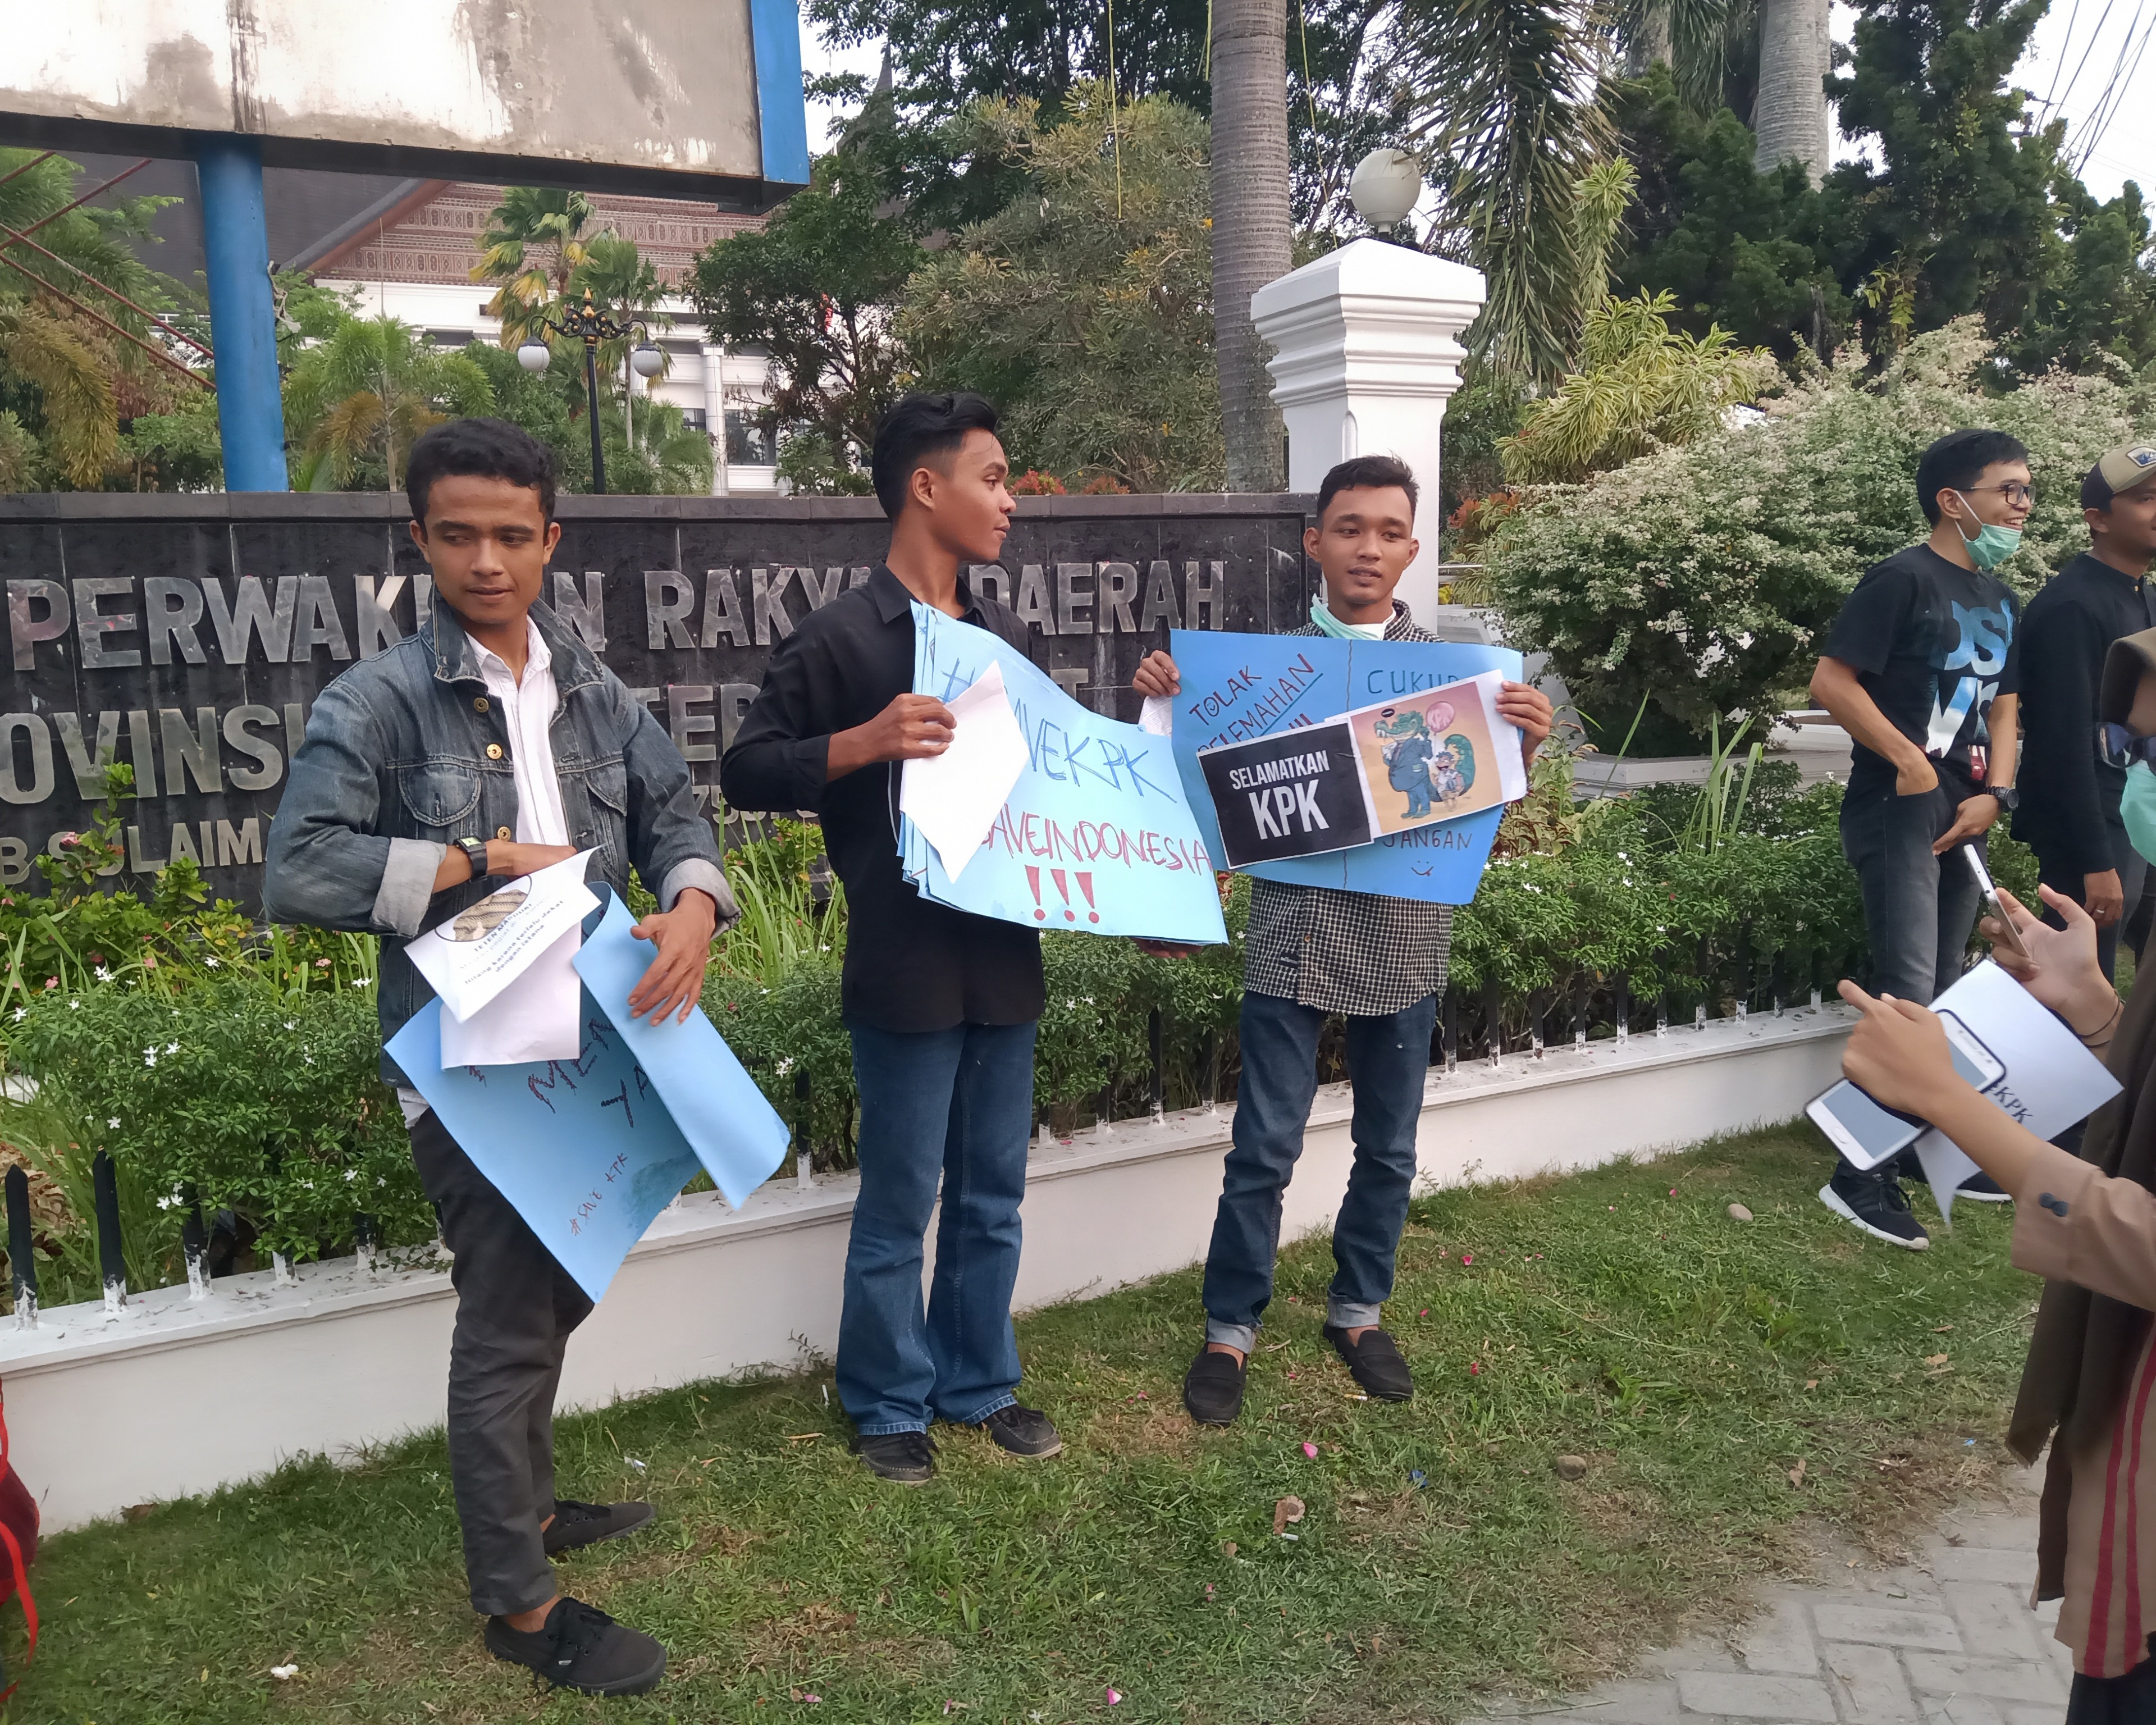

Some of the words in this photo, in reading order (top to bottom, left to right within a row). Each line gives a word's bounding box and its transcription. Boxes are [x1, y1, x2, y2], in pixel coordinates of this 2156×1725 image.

[6, 572, 605, 670] PERWAKIN
[969, 560, 1223, 636] DAERAH
[1189, 665, 1262, 725] TOLAK
[1230, 750, 1330, 790] SELAMATKAN
[1248, 779, 1330, 839] KPK
[48, 818, 267, 878] SULAIM
[1383, 829, 1472, 851] JANGAN
[605, 1152, 628, 1183] KPK
